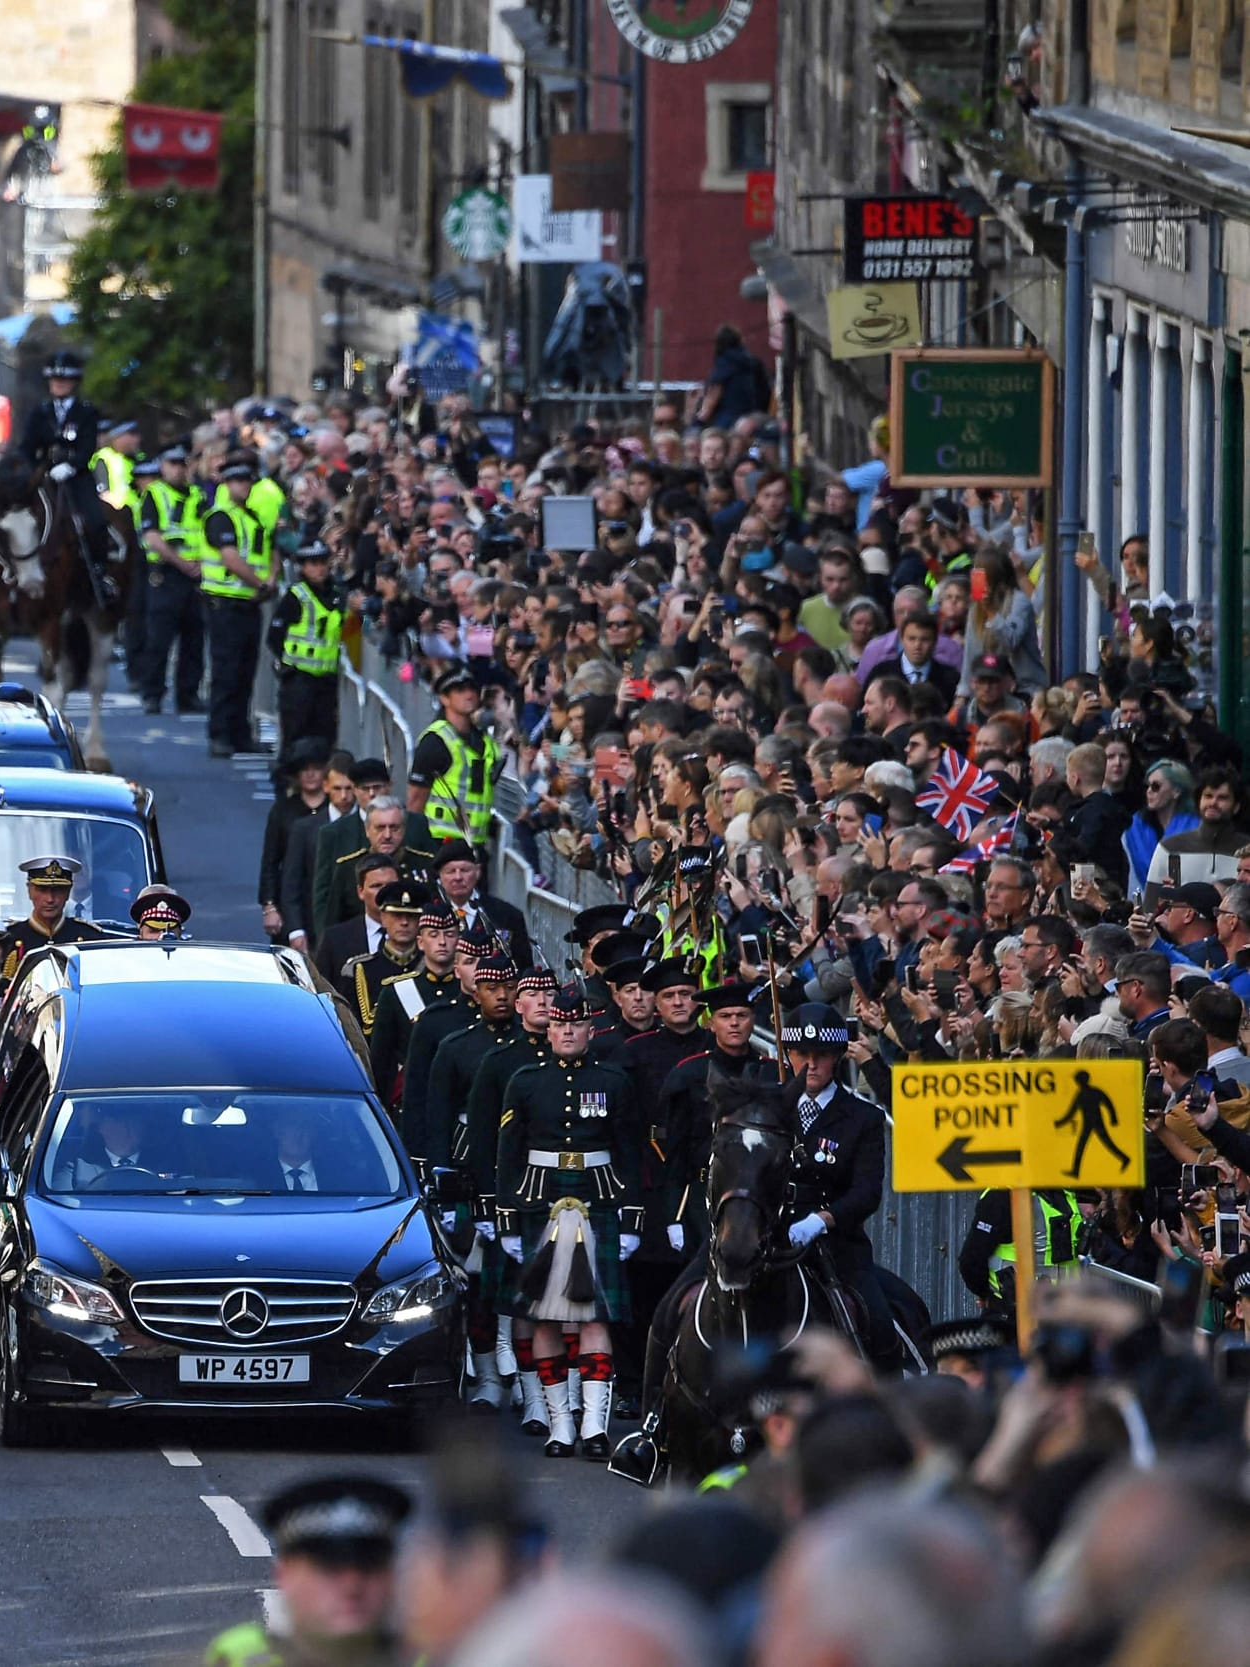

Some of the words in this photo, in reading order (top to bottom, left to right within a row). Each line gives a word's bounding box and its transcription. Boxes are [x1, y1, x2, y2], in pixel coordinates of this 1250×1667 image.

[862, 200, 974, 237] BENE'S
[863, 239, 905, 257] HOME
[906, 239, 973, 256] DELIVERY
[863, 259, 900, 279] 0131
[902, 259, 932, 278] 557
[910, 368, 1036, 398] Canongate
[930, 394, 1016, 423] Jerseys
[960, 420, 982, 443] &
[936, 445, 1007, 469] Crafts
[901, 1068, 1056, 1099] CROSSING
[934, 1103, 1019, 1131] POINT
[195, 1358, 226, 1381] WP
[232, 1358, 294, 1381] 4597
